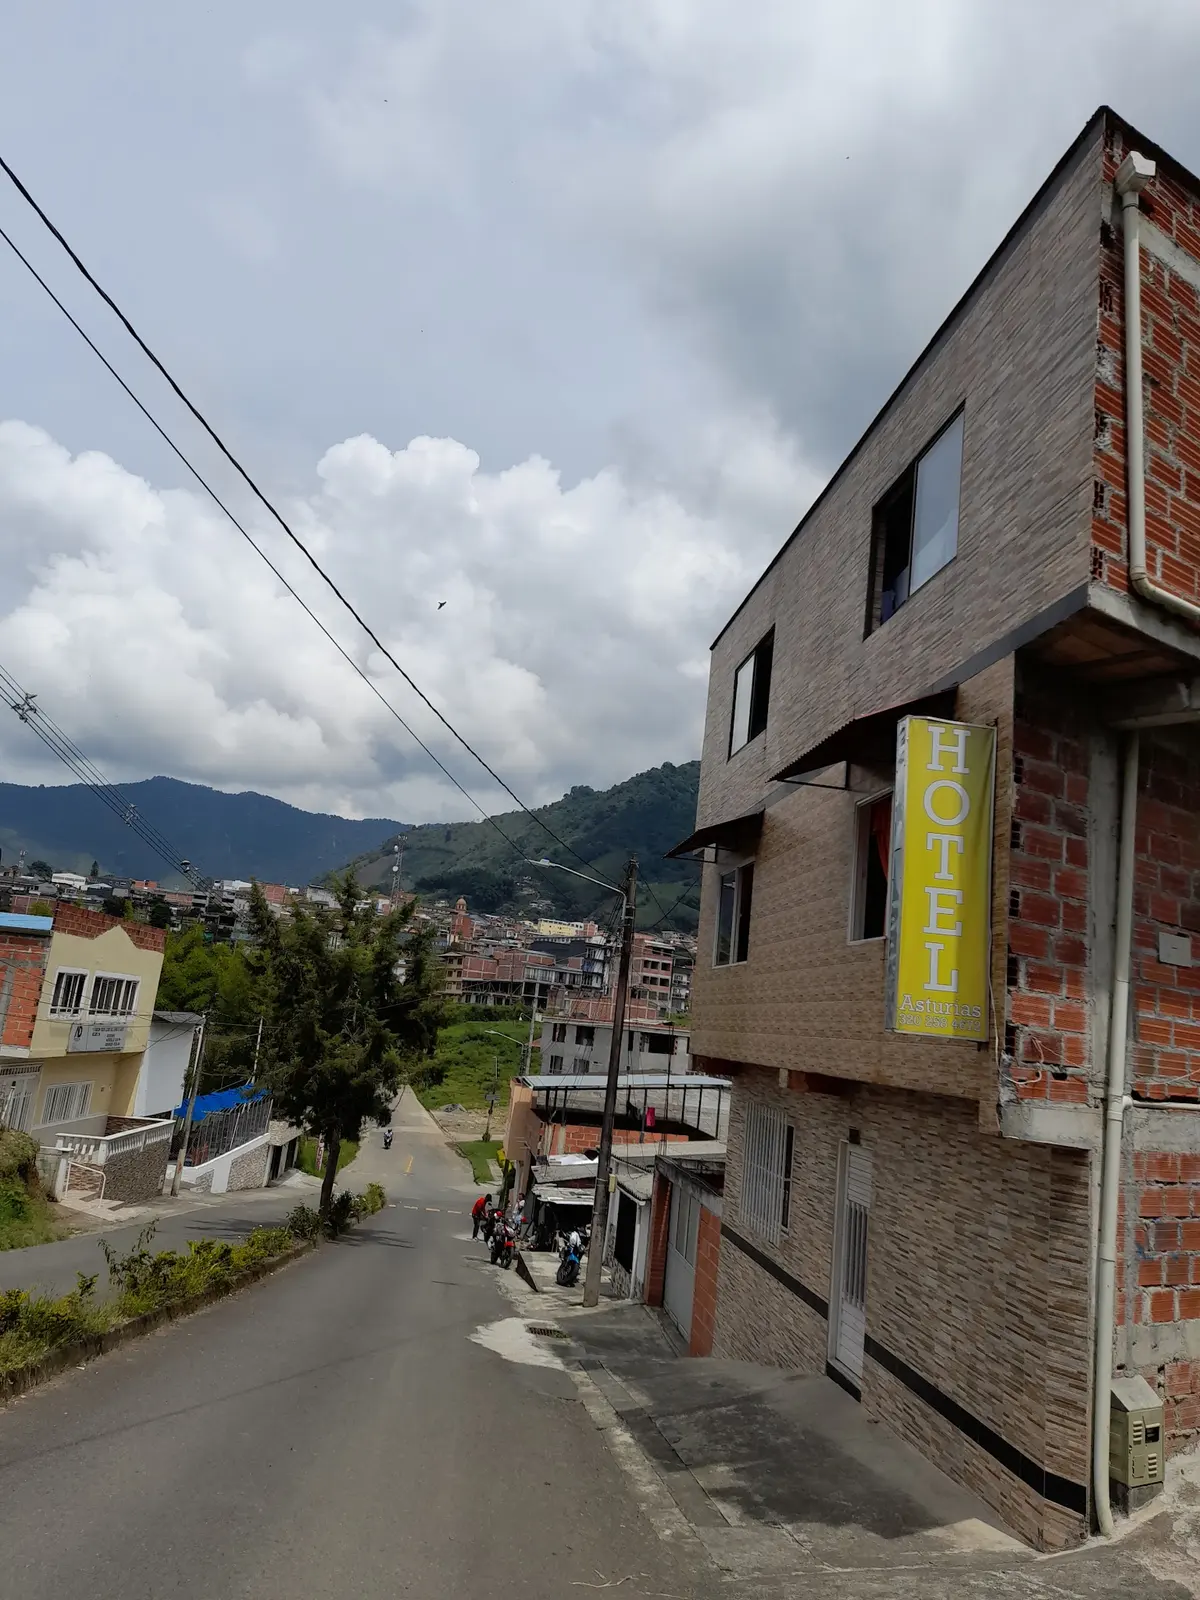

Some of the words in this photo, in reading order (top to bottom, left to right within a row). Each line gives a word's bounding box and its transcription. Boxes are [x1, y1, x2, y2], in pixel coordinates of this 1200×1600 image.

[923, 725, 971, 993] HOTEL
[899, 994, 981, 1018] Asturias
[899, 1013, 922, 1026] 320
